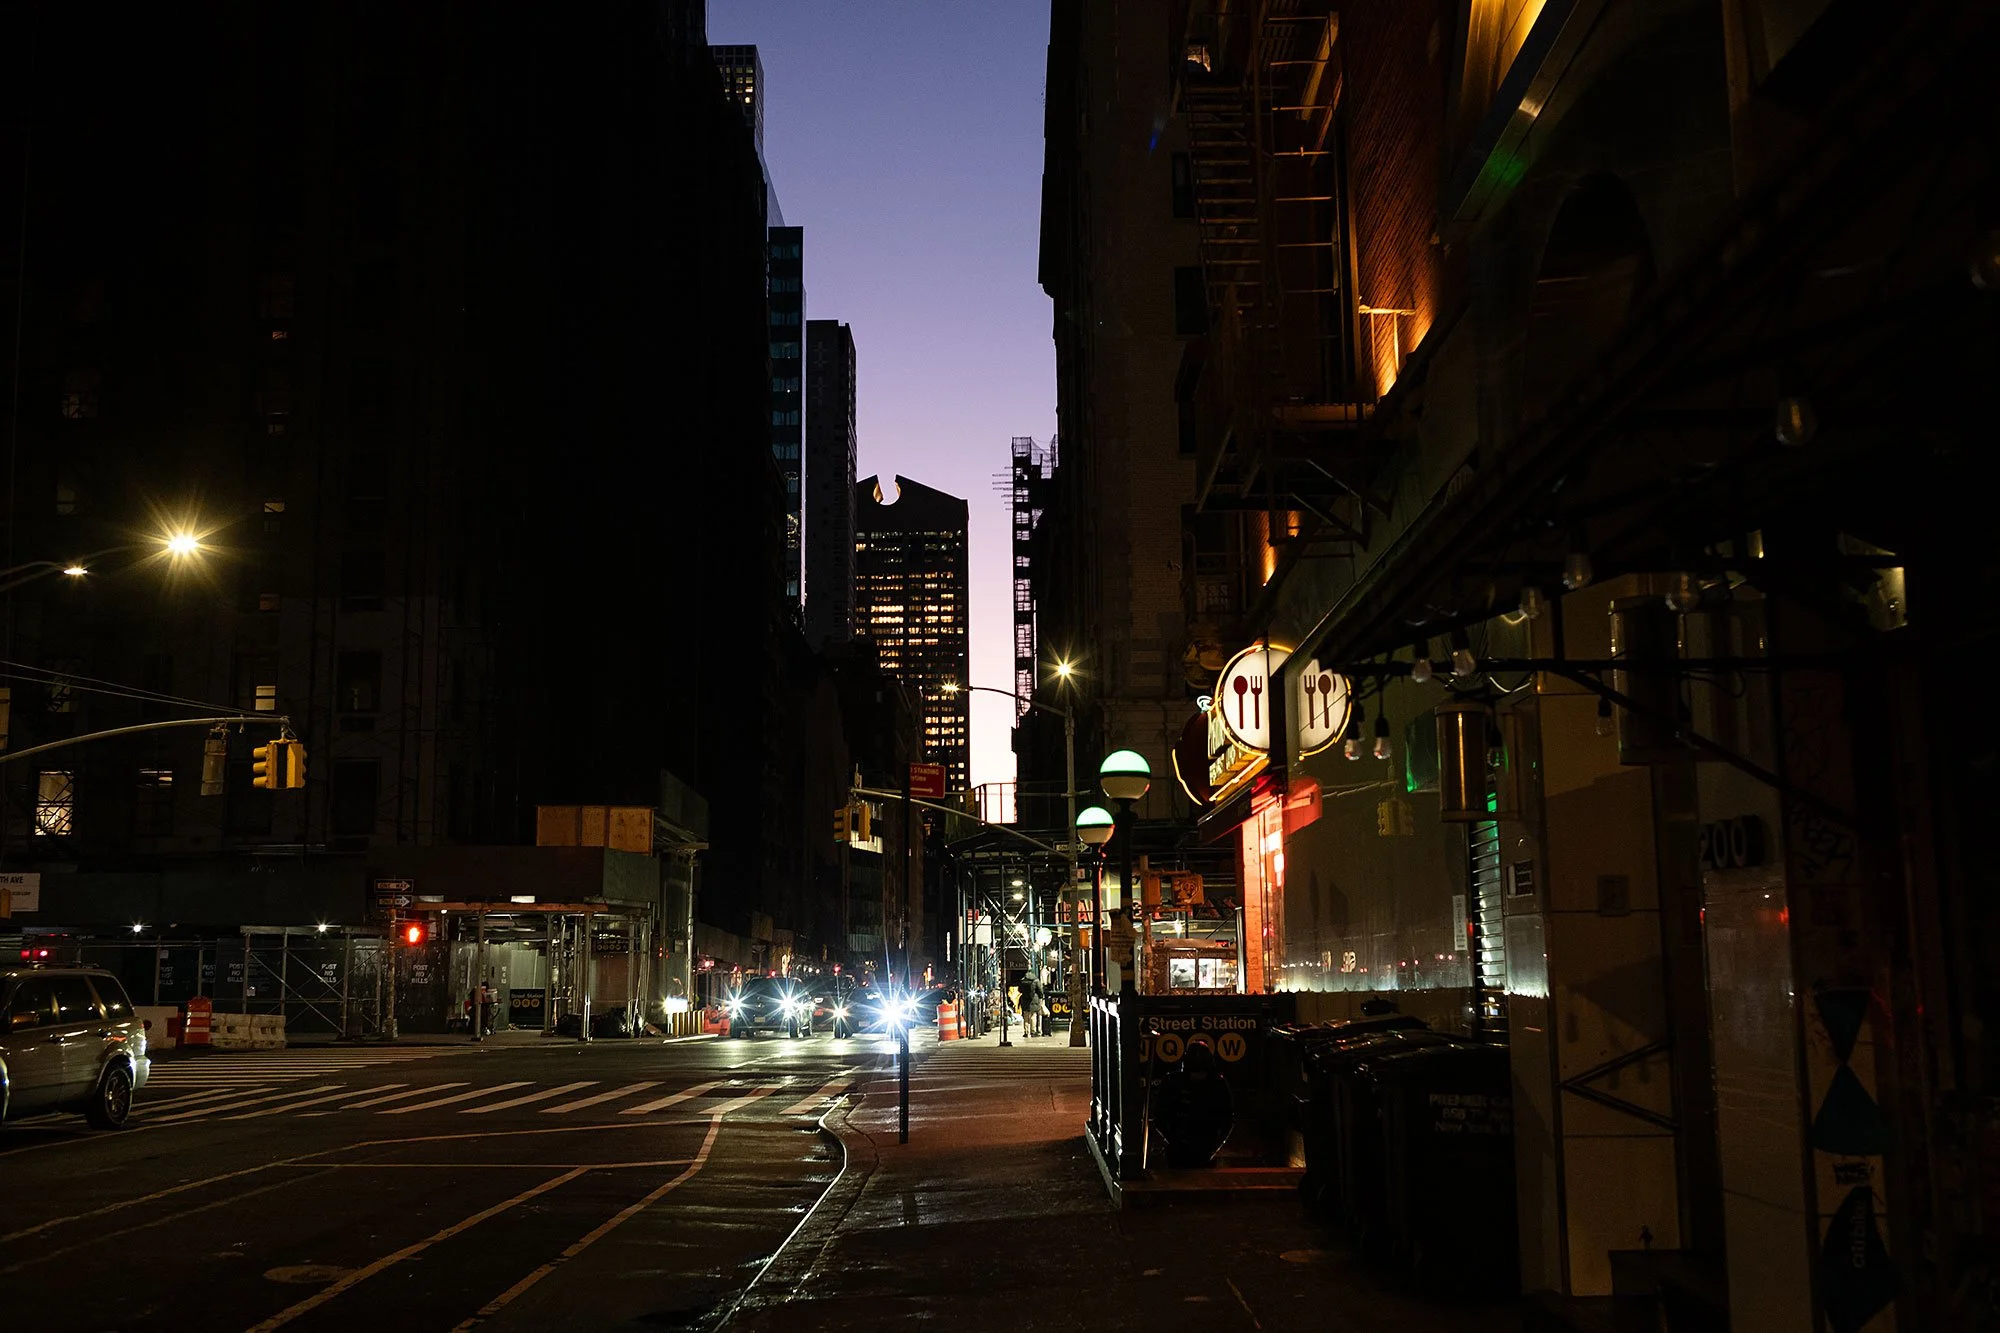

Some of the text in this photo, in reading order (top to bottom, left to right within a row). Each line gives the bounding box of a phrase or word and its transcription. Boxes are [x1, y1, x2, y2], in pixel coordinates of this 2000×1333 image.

[1699, 819, 1748, 870] 200
[10, 876, 24, 884] AVE
[1148, 1016, 1197, 1030] Street
[1201, 1015, 1257, 1030] Station
